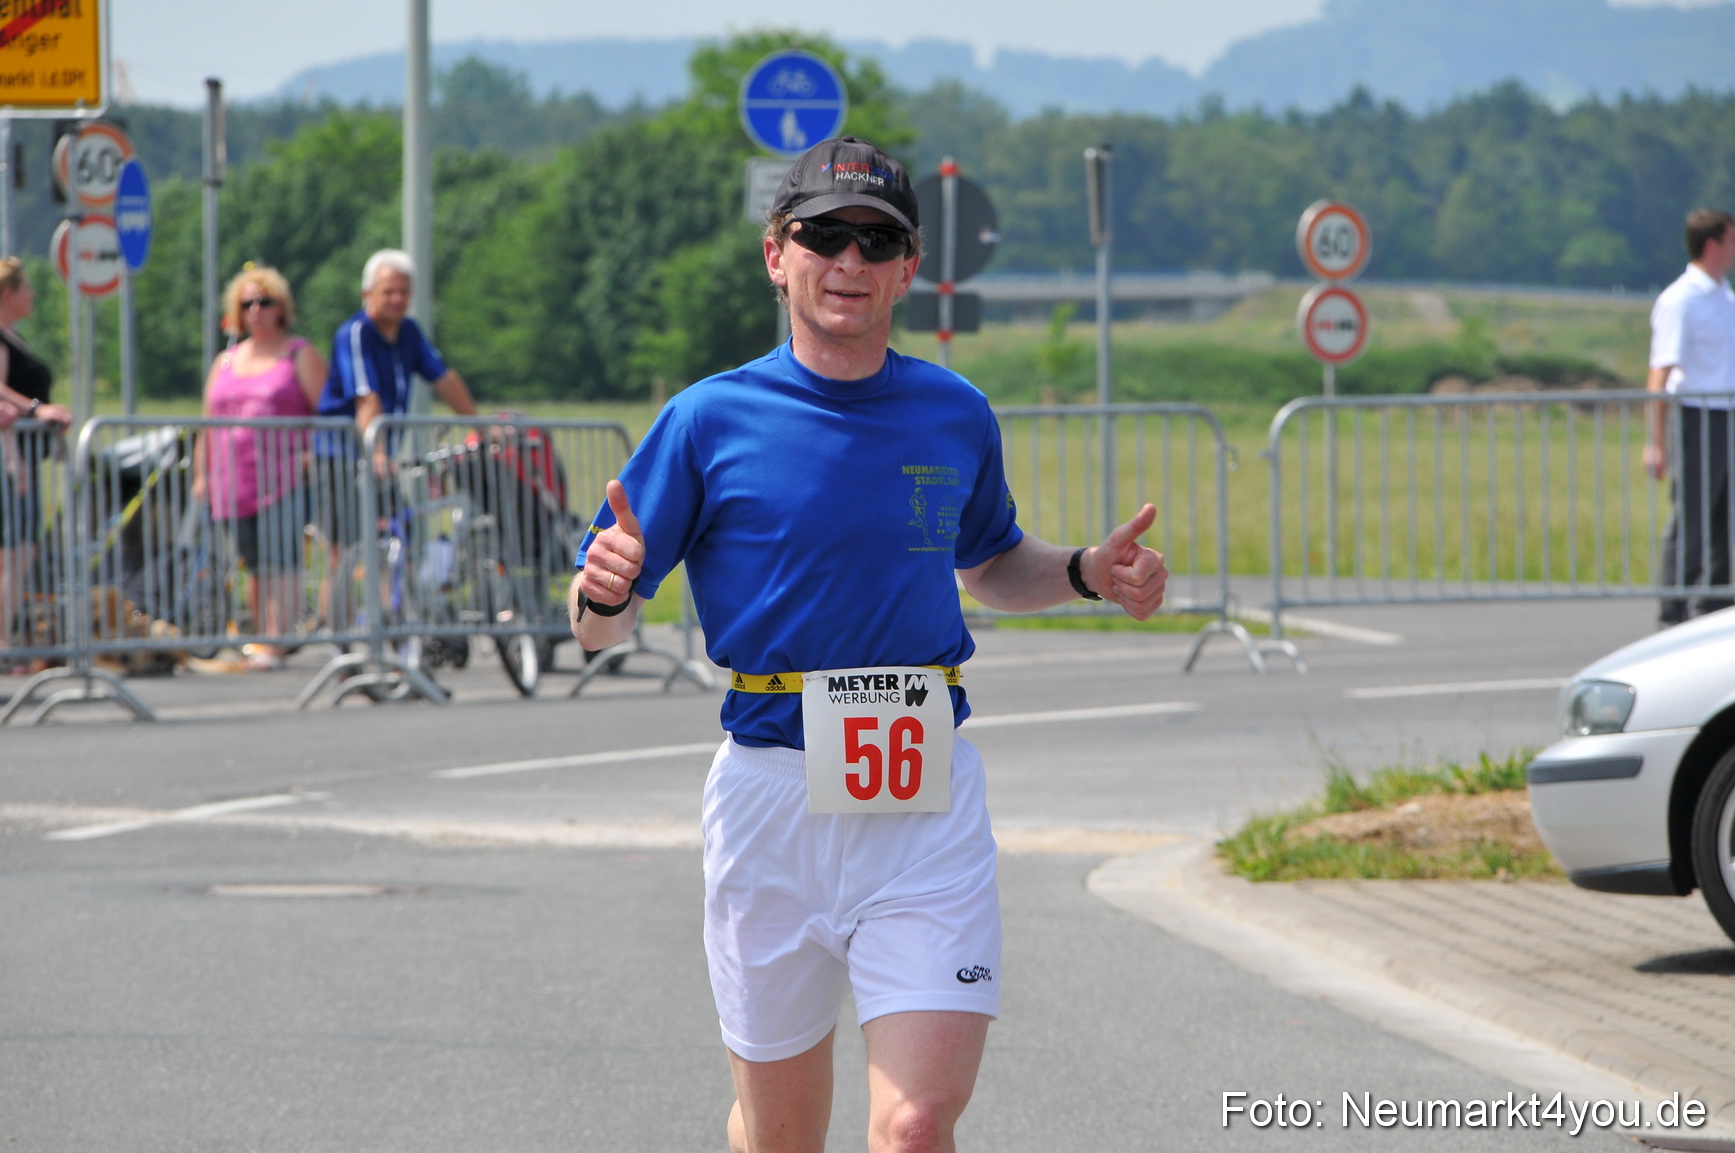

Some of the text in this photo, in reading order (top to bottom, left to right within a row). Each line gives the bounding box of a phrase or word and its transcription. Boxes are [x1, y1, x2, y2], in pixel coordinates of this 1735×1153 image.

[77, 148, 117, 184] 60
[836, 172, 885, 187] HACKNER
[1319, 226, 1351, 259] 60
[765, 683, 787, 692] adidas
[828, 674, 900, 692] MEYER
[828, 691, 901, 705] WERBUNG
[843, 716, 924, 801] 56
